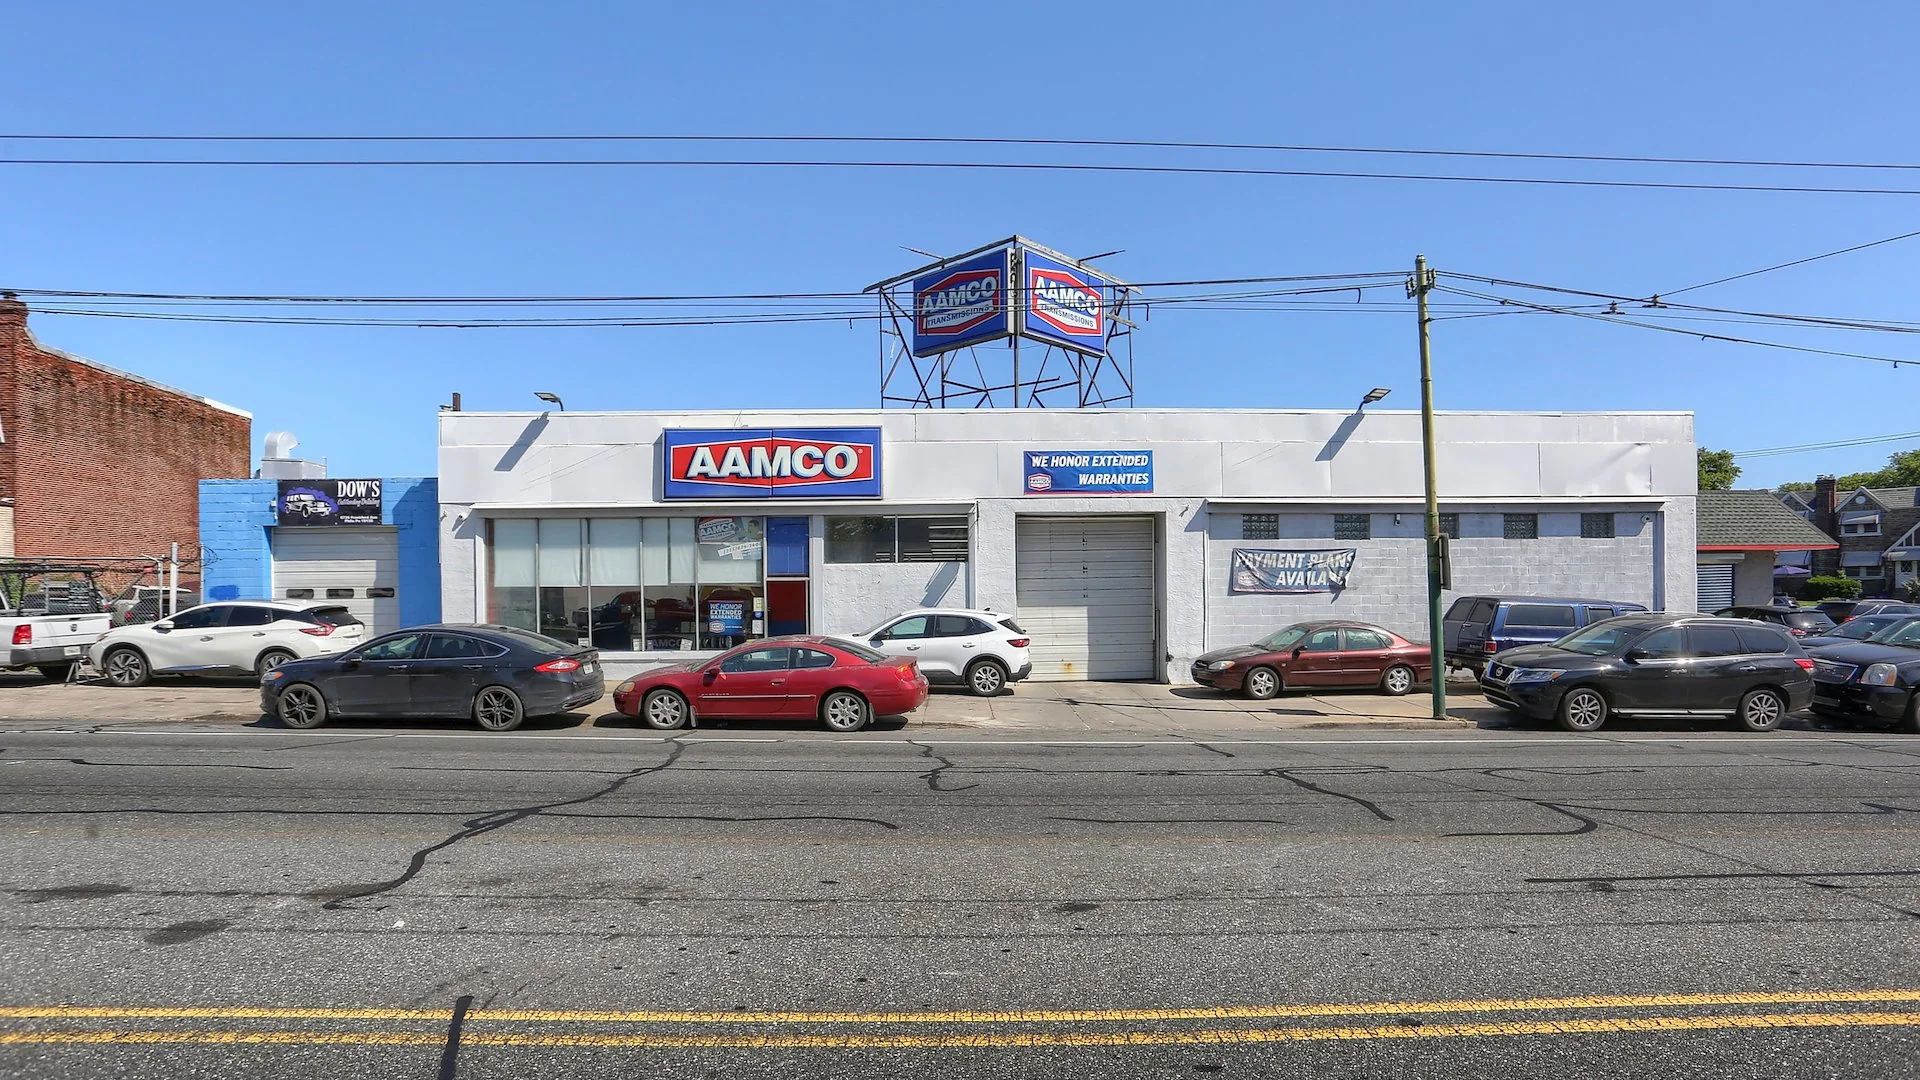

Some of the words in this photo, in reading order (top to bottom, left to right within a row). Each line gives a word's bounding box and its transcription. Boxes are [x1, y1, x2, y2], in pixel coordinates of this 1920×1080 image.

[922, 276, 997, 313] AAMCO
[1034, 276, 1099, 315] AAMCO
[927, 304, 990, 327] TRANSMISSIONS
[1041, 304, 1094, 328] TRANSMISSIONS
[687, 445, 859, 479] AAMCO
[1031, 456, 1048, 467] WE
[1051, 455, 1090, 467] HONOR
[1092, 455, 1149, 467] EXTENDED
[1079, 473, 1149, 485] WARRANTIES
[337, 481, 380, 497] DOW'S
[701, 523, 736, 536] AAMCO
[1275, 571, 1329, 585] AVAILA
[651, 638, 681, 648] AMC
